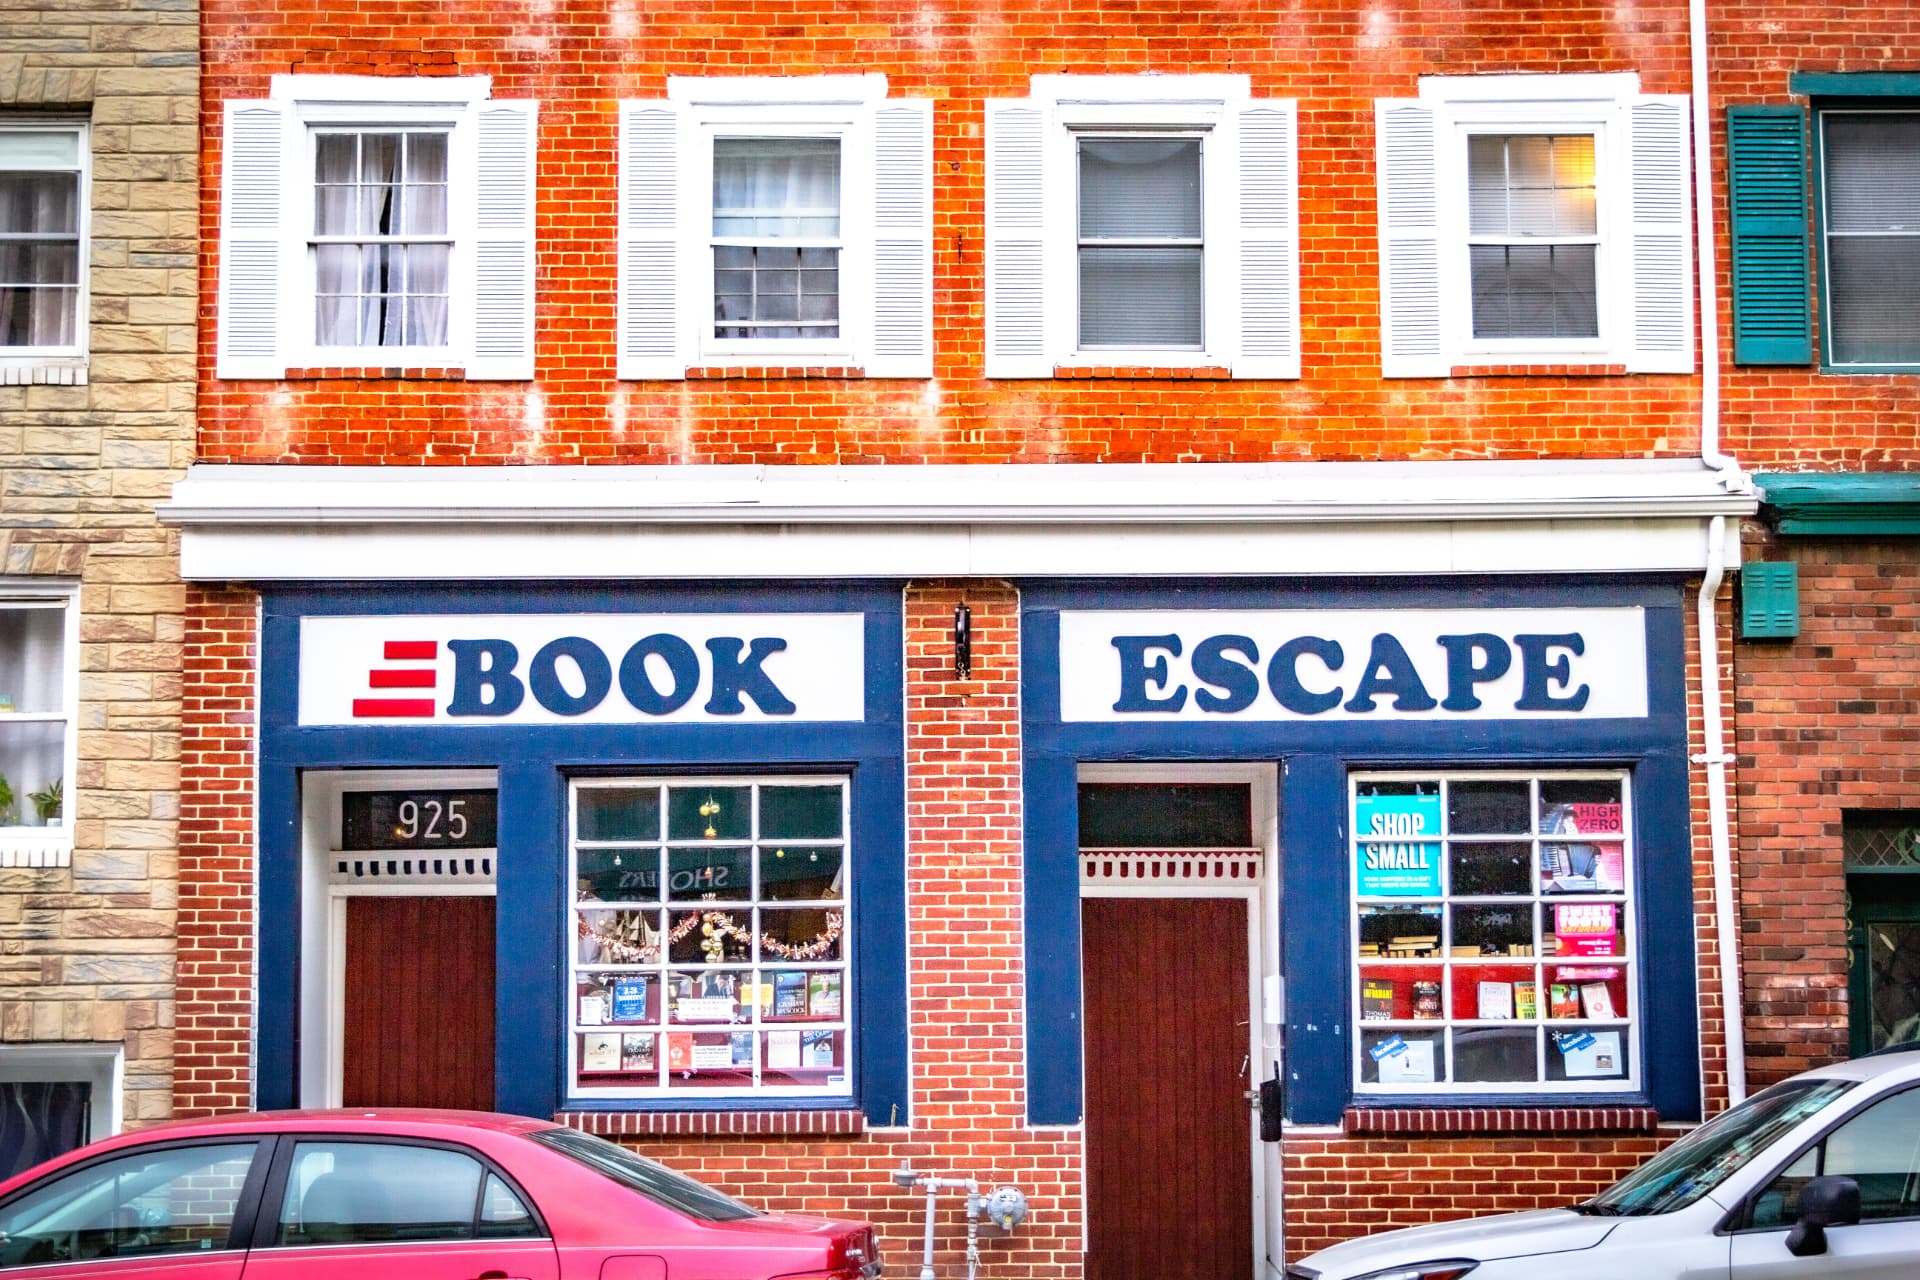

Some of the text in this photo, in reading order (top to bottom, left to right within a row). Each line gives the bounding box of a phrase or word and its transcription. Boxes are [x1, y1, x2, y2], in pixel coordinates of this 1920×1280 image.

[446, 632, 1590, 717] BOOK ESCAPE
[397, 800, 467, 839] 925
[1579, 805, 1620, 817] HIGH
[1579, 818, 1620, 830] ZERO
[1370, 812, 1425, 838] SHOP
[1365, 843, 1431, 870] SMALL
[1559, 905, 1611, 916] SWEET
